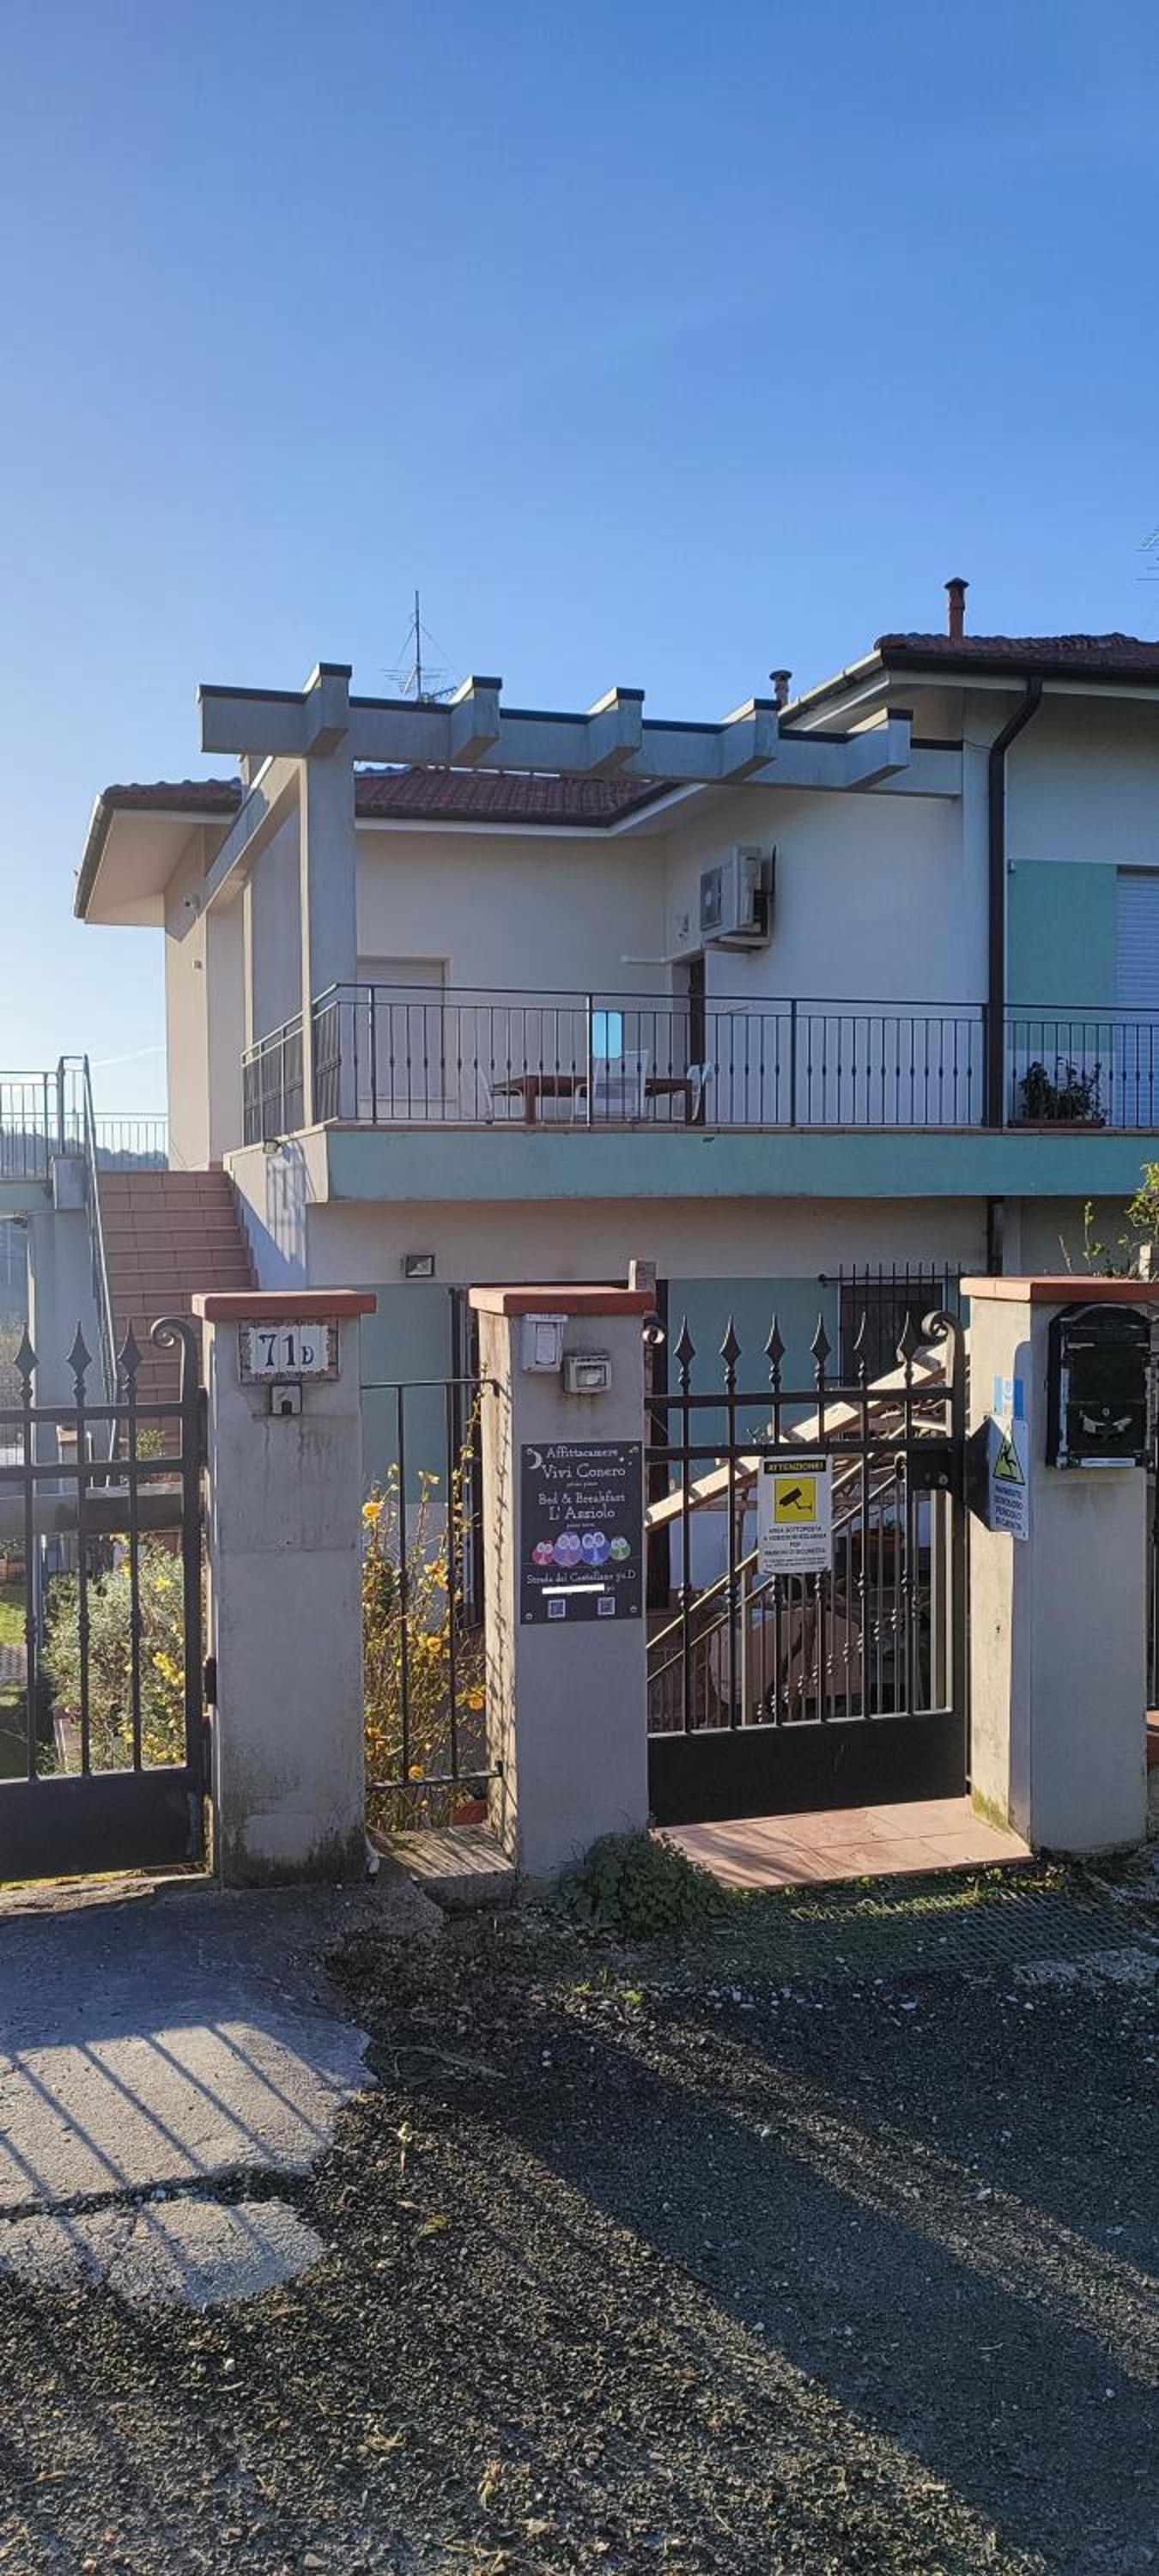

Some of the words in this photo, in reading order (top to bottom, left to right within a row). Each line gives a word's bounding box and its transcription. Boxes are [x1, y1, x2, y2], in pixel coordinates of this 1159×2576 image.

[546, 1445, 618, 1459] Affittacamere
[541, 1464, 572, 1479] Vivi
[576, 1463, 626, 1478] Conero
[768, 1461, 824, 1472] ATTENZIONE!
[538, 1492, 558, 1505] Bed
[561, 1493, 572, 1504] &
[576, 1490, 625, 1504] Breakfast
[549, 1506, 561, 1521] L'
